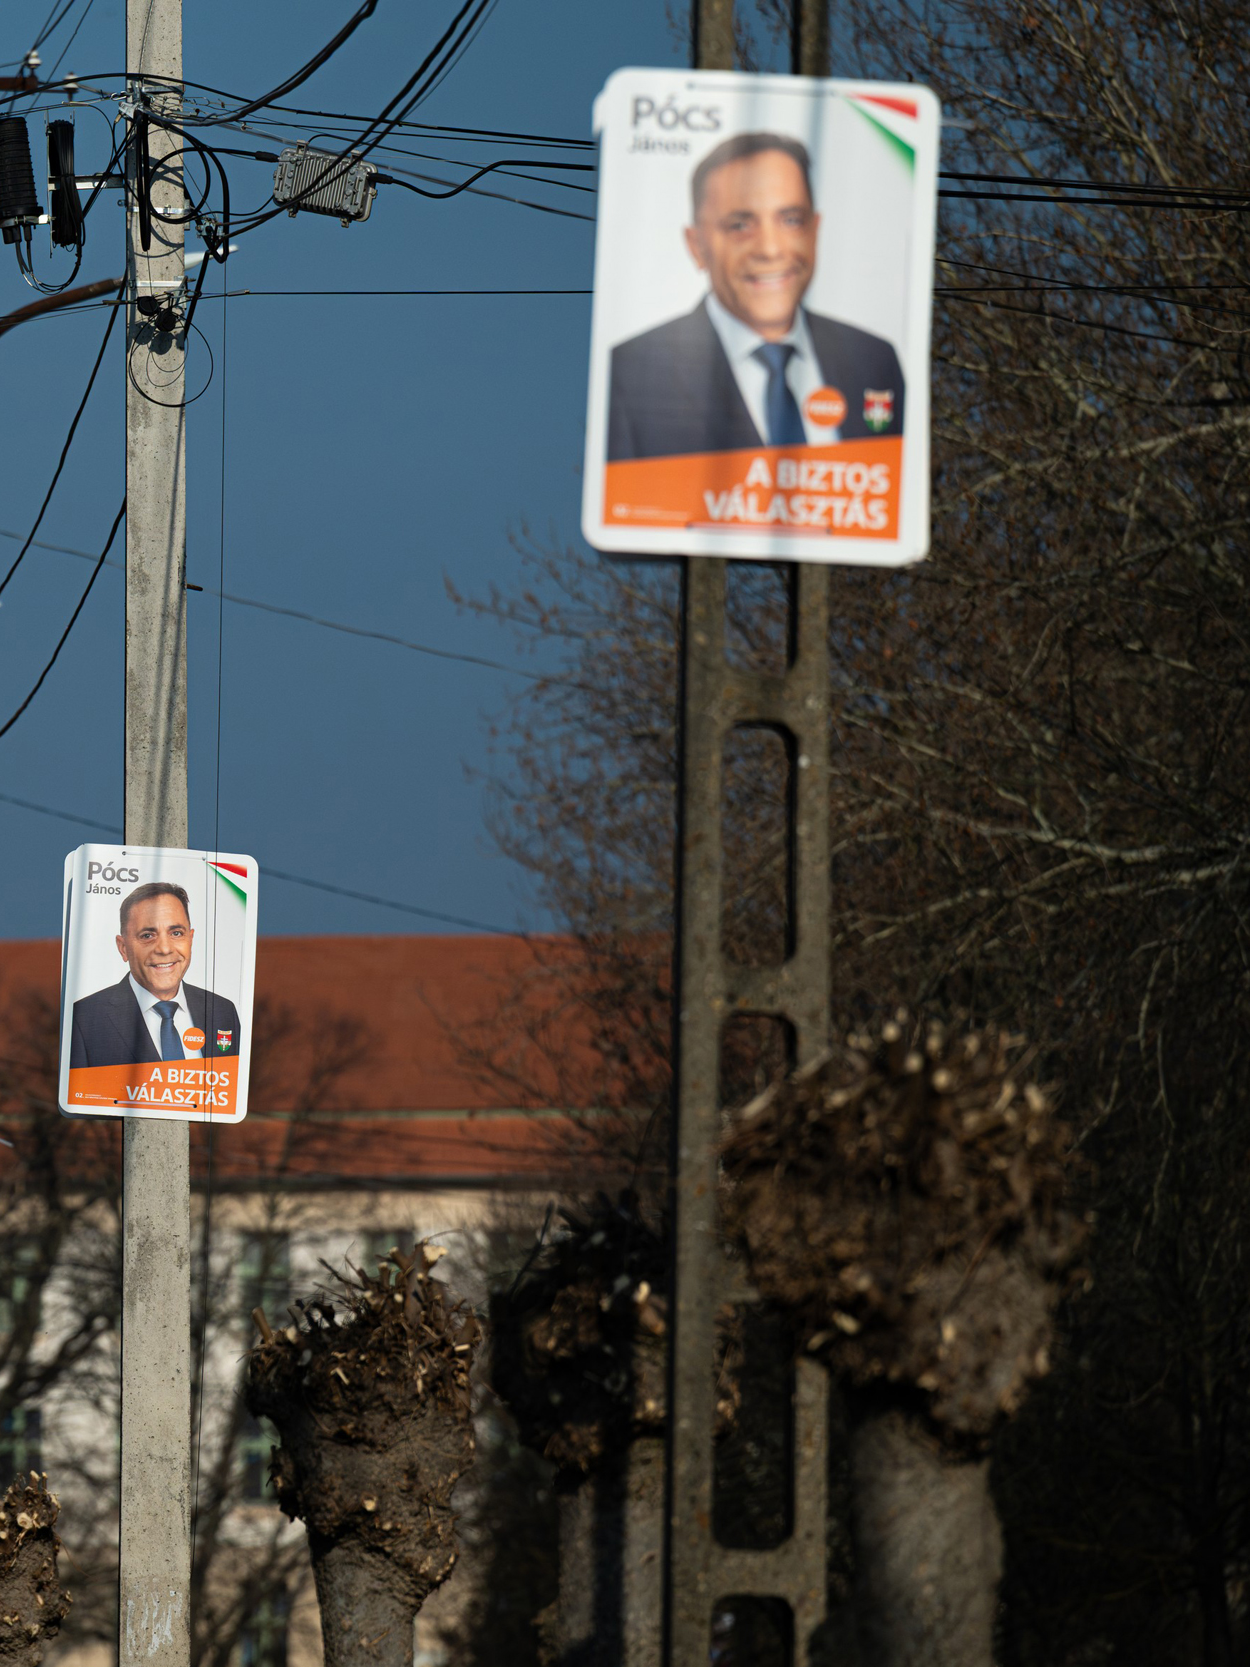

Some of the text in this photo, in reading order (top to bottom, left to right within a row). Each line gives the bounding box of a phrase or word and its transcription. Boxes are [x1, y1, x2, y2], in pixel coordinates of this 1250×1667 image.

[631, 94, 720, 131] Pócs
[746, 458, 890, 494] A BIZTOS
[704, 483, 889, 530] VÁLASZTÁS
[87, 861, 139, 883] Pócs
[86, 884, 121, 896] János
[183, 1035, 205, 1043] FIDESZ
[150, 1067, 230, 1087] A BIZTOS
[126, 1082, 229, 1106] VÁLASZTÁS
